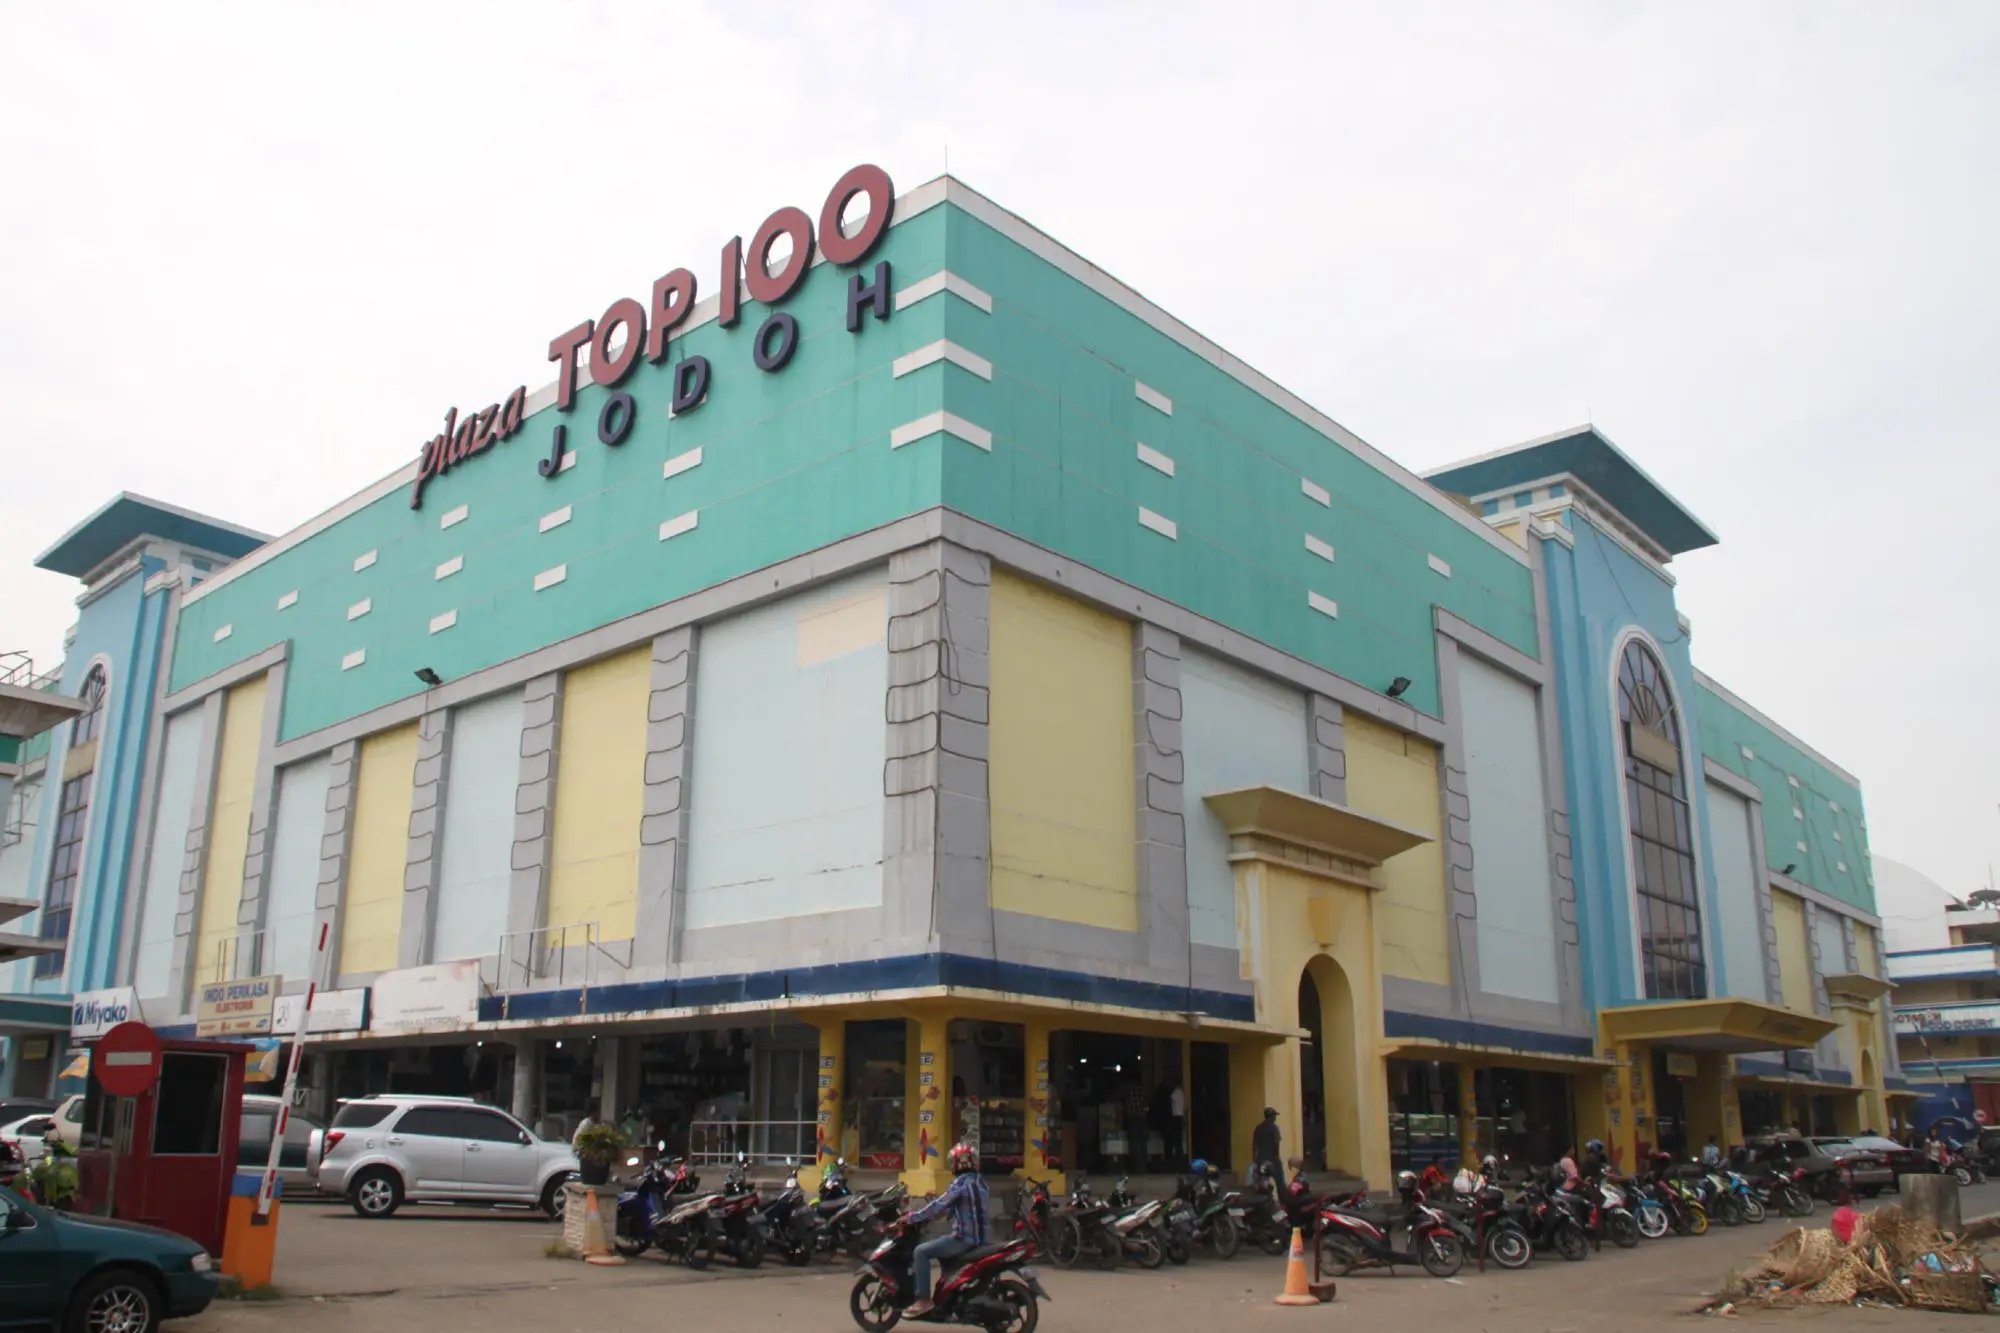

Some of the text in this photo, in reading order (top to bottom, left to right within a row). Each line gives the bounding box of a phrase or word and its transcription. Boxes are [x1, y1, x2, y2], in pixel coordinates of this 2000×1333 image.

[410, 163, 895, 510] plaza TOP 100
[538, 260, 893, 478] JODOH
[85, 997, 128, 1032] Miyako
